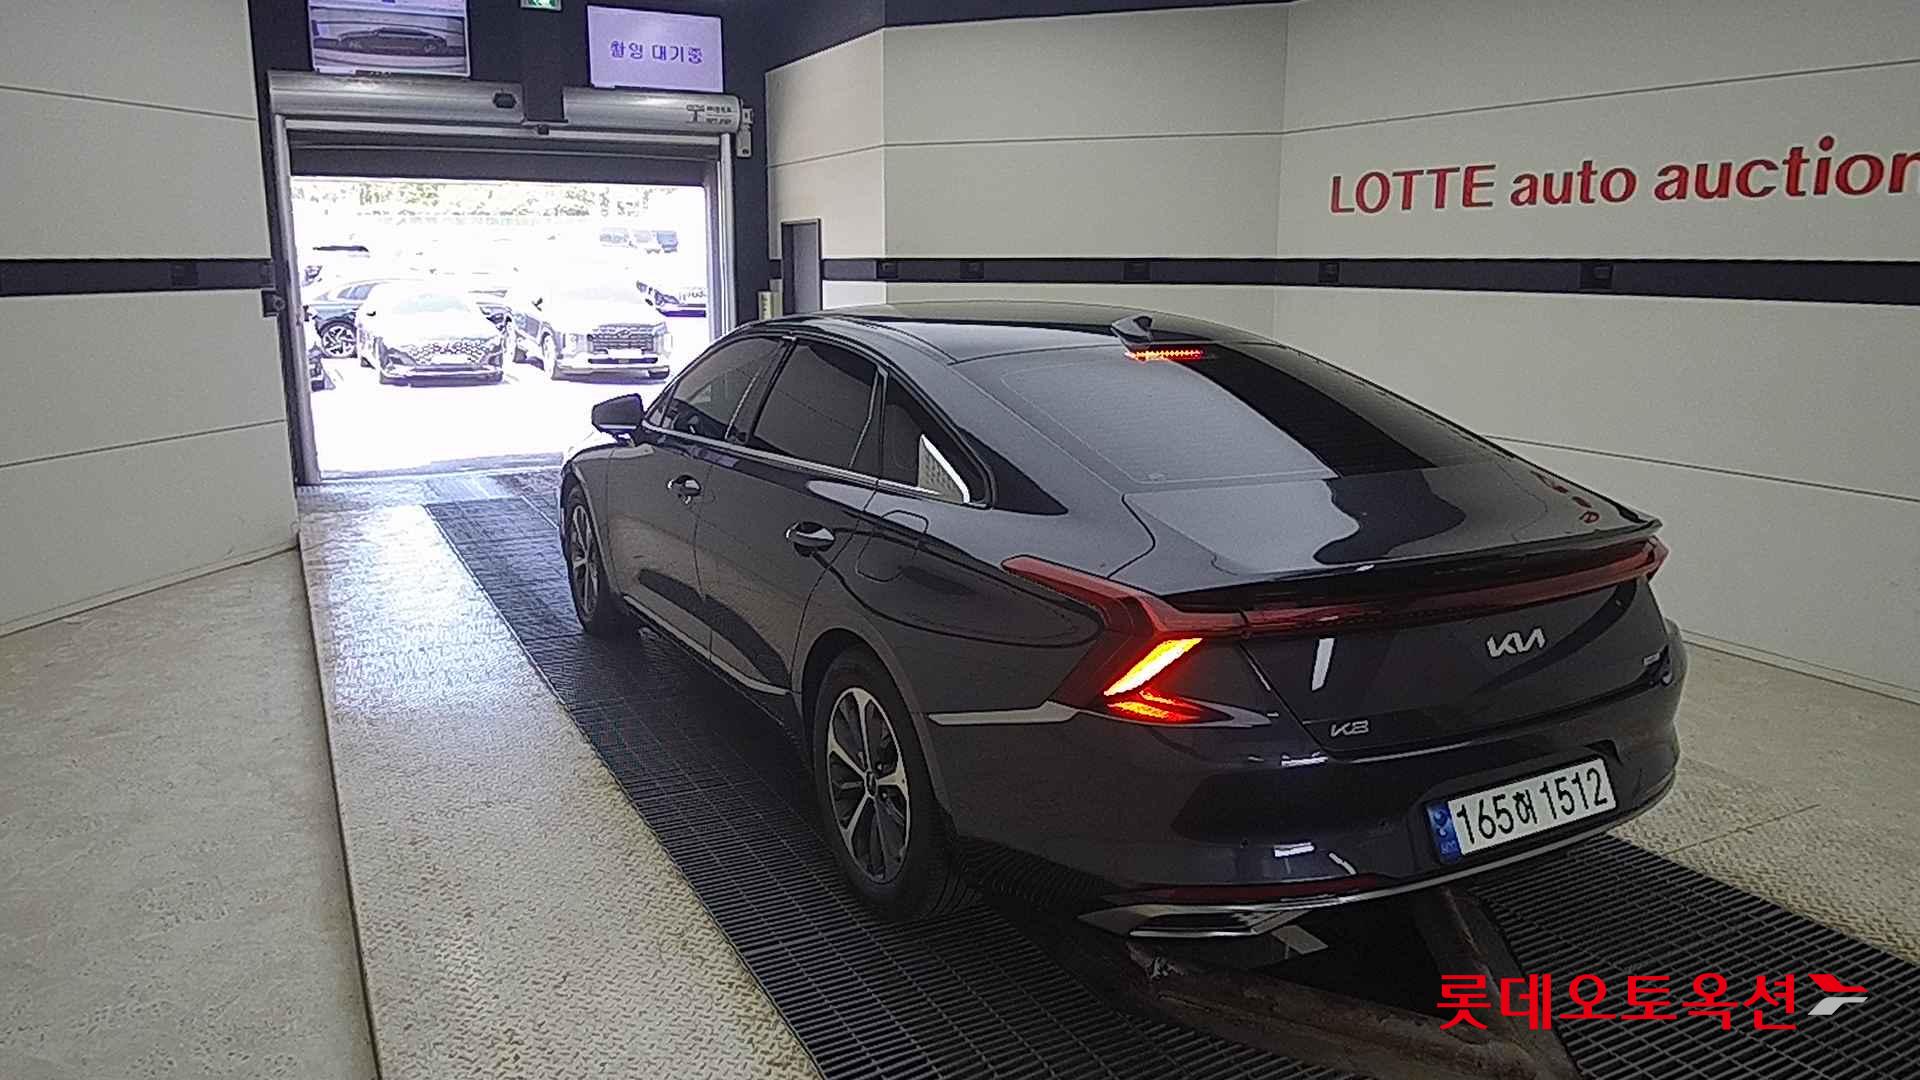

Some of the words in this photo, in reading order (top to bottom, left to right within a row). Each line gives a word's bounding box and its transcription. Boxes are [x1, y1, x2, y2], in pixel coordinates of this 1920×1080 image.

[652, 44, 702, 64] 대기중
[1331, 164, 1496, 213] LOTTE
[1510, 160, 1637, 206] auto
[1654, 135, 1920, 201] auction
[1331, 720, 1369, 738] K8
